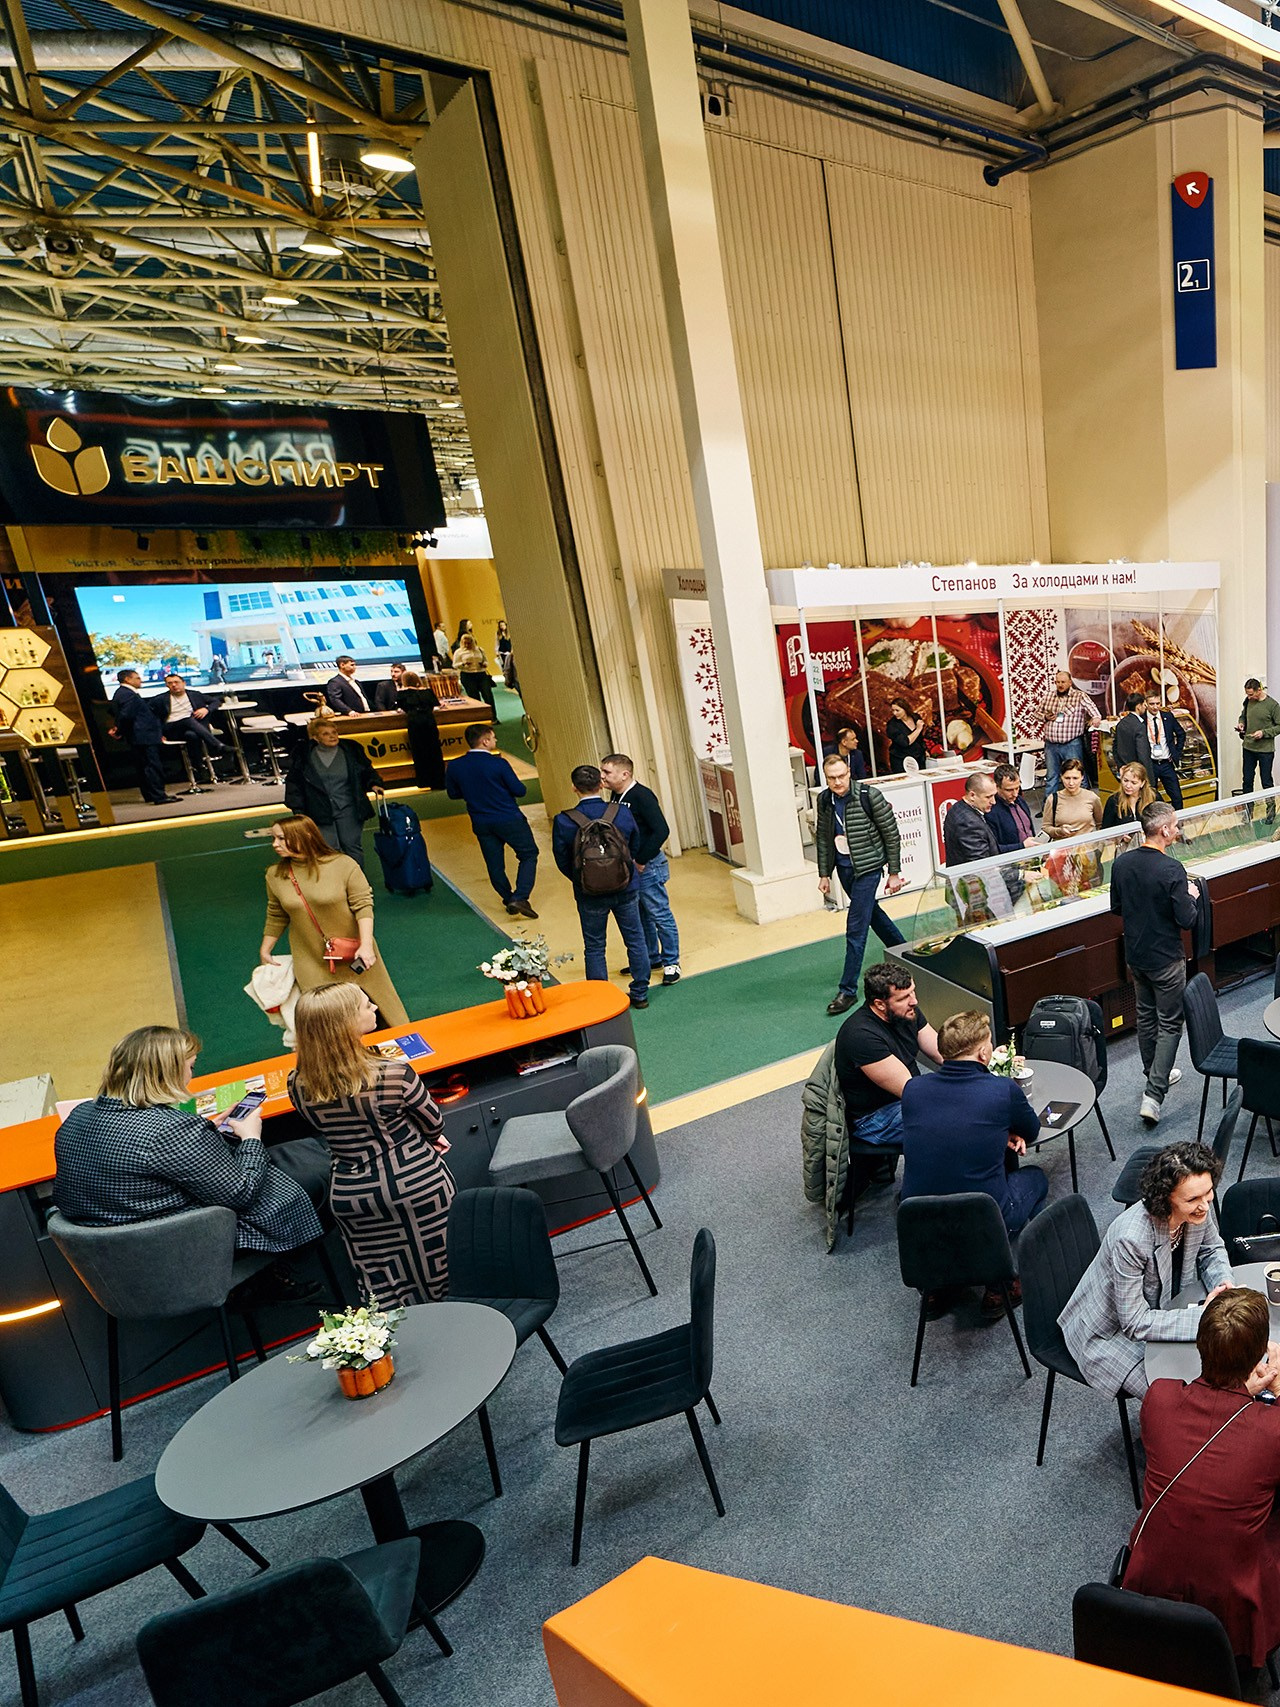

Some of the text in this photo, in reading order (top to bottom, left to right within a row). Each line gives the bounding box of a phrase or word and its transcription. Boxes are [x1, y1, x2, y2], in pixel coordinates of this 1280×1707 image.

[120, 455, 385, 488] БАШСПИРТ
[931, 569, 1137, 592] Степанов За холодцами к нам!
[389, 736, 463, 753] БАИРТ
[894, 805, 922, 820] сский
